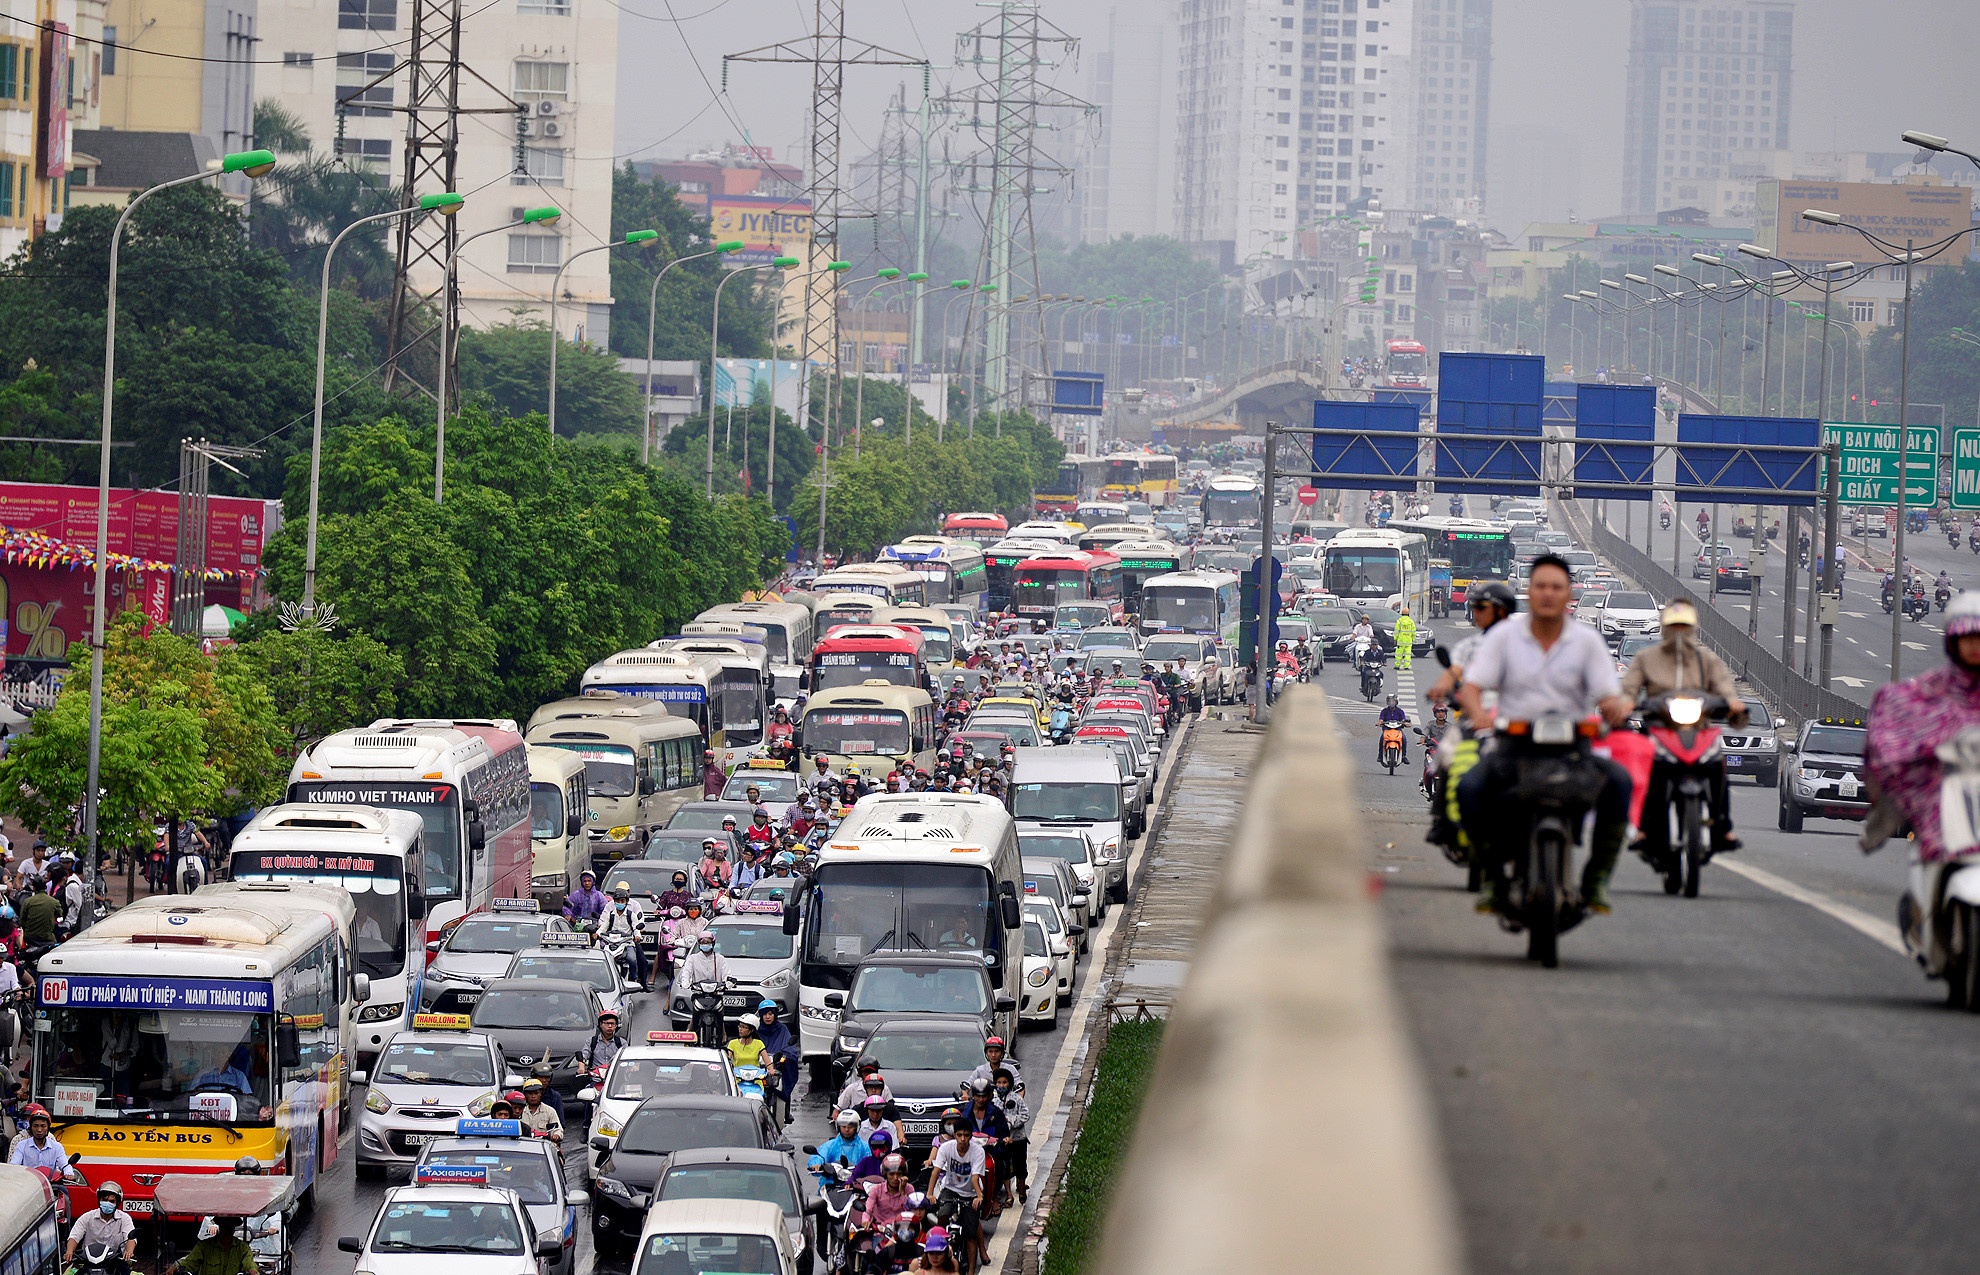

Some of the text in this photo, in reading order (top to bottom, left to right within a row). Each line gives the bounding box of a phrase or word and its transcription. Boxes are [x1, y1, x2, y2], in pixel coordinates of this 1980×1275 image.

[739, 213, 806, 234] JYMEC
[1822, 427, 1920, 450] ÂN BAY NỘI ÀI
[1847, 456, 1881, 475] DỊCH
[1847, 478, 1881, 499] GIẤY
[698, 692, 702, 700] 2
[308, 791, 435, 803] KUMHO VIET THANH
[261, 856, 273, 868] BX
[274, 855, 302, 869] QUỲNH
[303, 854, 318, 868] CÔI
[325, 857, 337, 870] BX
[338, 855, 352, 870] MỸ
[352, 857, 374, 871] ĐÌNH
[71, 986, 90, 1002] KĐT
[92, 984, 117, 1002] PHÁP
[119, 984, 138, 1003] VÂN
[141, 984, 154, 1003] TỨ
[154, 985, 176, 1006] HIỆP
[185, 989, 207, 1004] NAM
[210, 987, 240, 1005] THĂNG
[243, 991, 268, 1007] LONG
[200, 1098, 220, 1107] KĐT
[87, 1128, 212, 1144] BẢO YẾN BUS
[902, 1124, 939, 1134] 0A-805.88
[426, 1169, 485, 1177] TAXIGROUP
